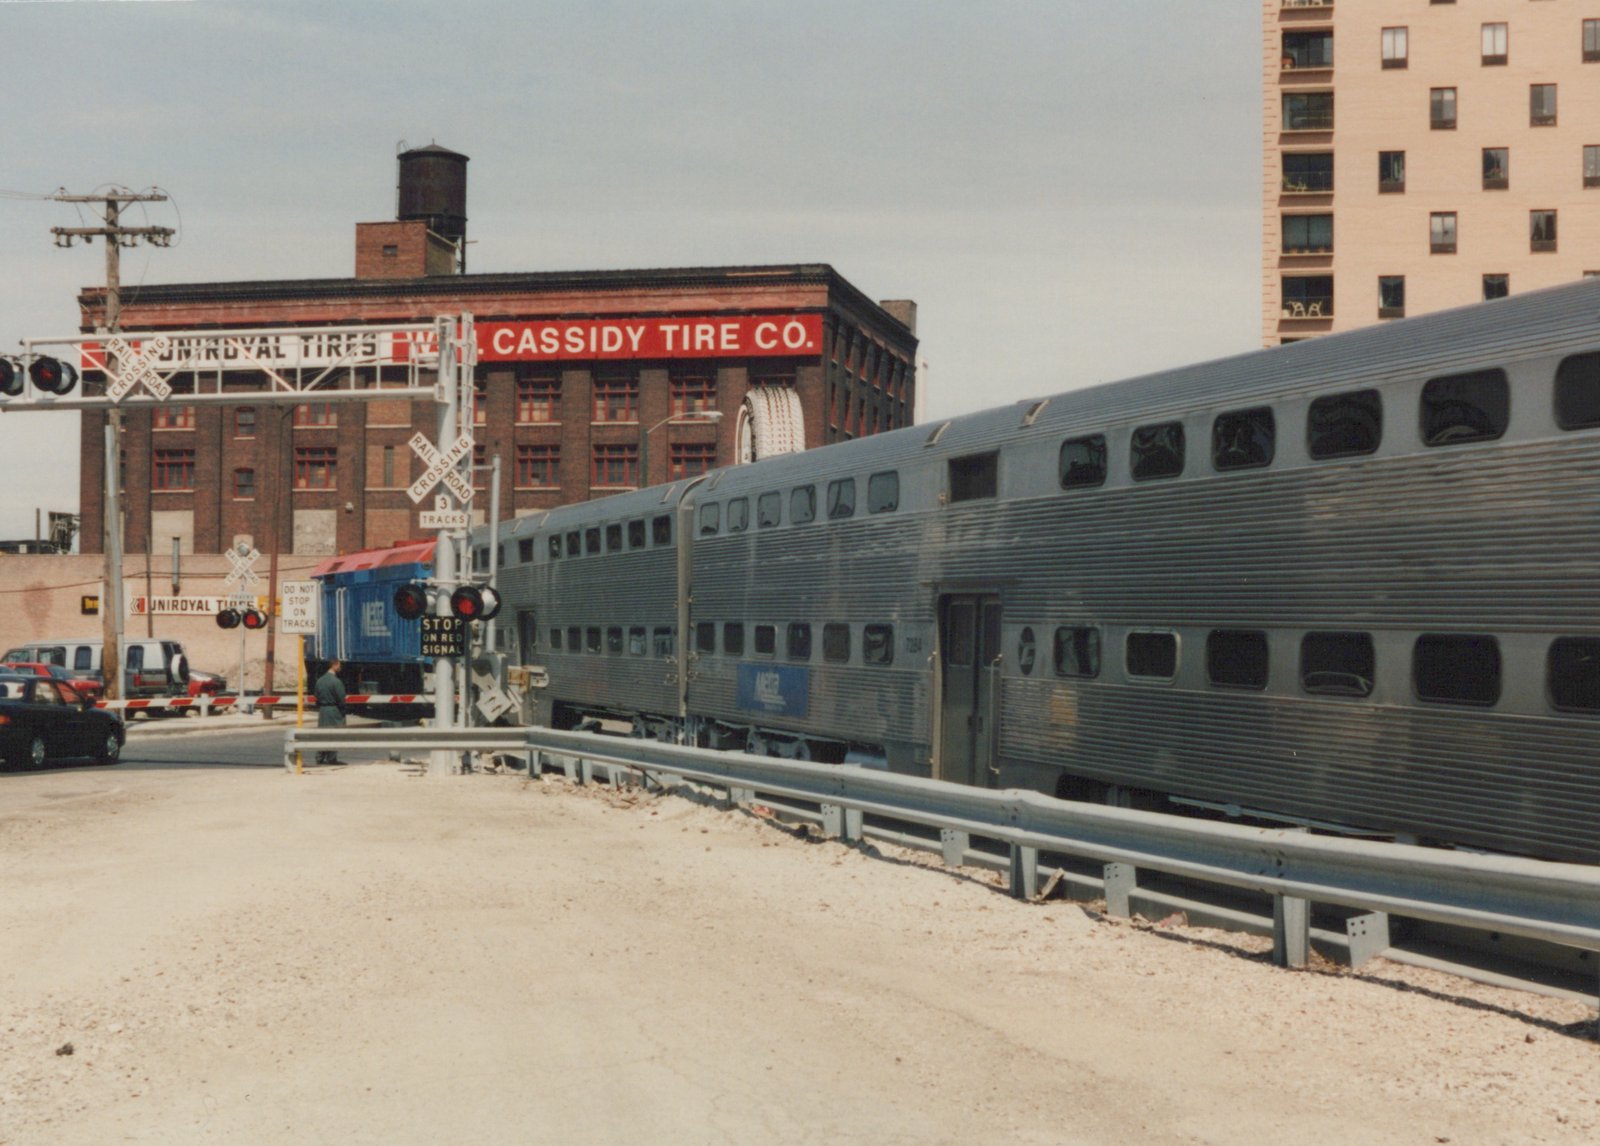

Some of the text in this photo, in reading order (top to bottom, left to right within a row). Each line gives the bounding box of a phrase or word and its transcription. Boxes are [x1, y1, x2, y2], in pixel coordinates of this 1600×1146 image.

[493, 326, 646, 354] CASSIDY
[659, 323, 740, 351] TIRE
[755, 321, 813, 349] CO.
[111, 338, 132, 362] RAIL
[112, 339, 166, 397] CROSSING
[142, 369, 168, 397] ROAD
[412, 436, 435, 462] RAIL
[413, 438, 469, 496] CROSSING
[445, 471, 471, 499] ROAD
[439, 497, 448, 510] 3
[423, 515, 465, 524] TRACKS
[284, 584, 315, 594] DO NOT
[150, 599, 211, 612] UNIROYAL
[289, 596, 310, 605] STOP
[293, 607, 306, 617] ON
[283, 619, 316, 628] TRACKS
[423, 618, 462, 630] STOP
[423, 633, 462, 642] ON RED
[423, 644, 462, 655] SIGNAL
